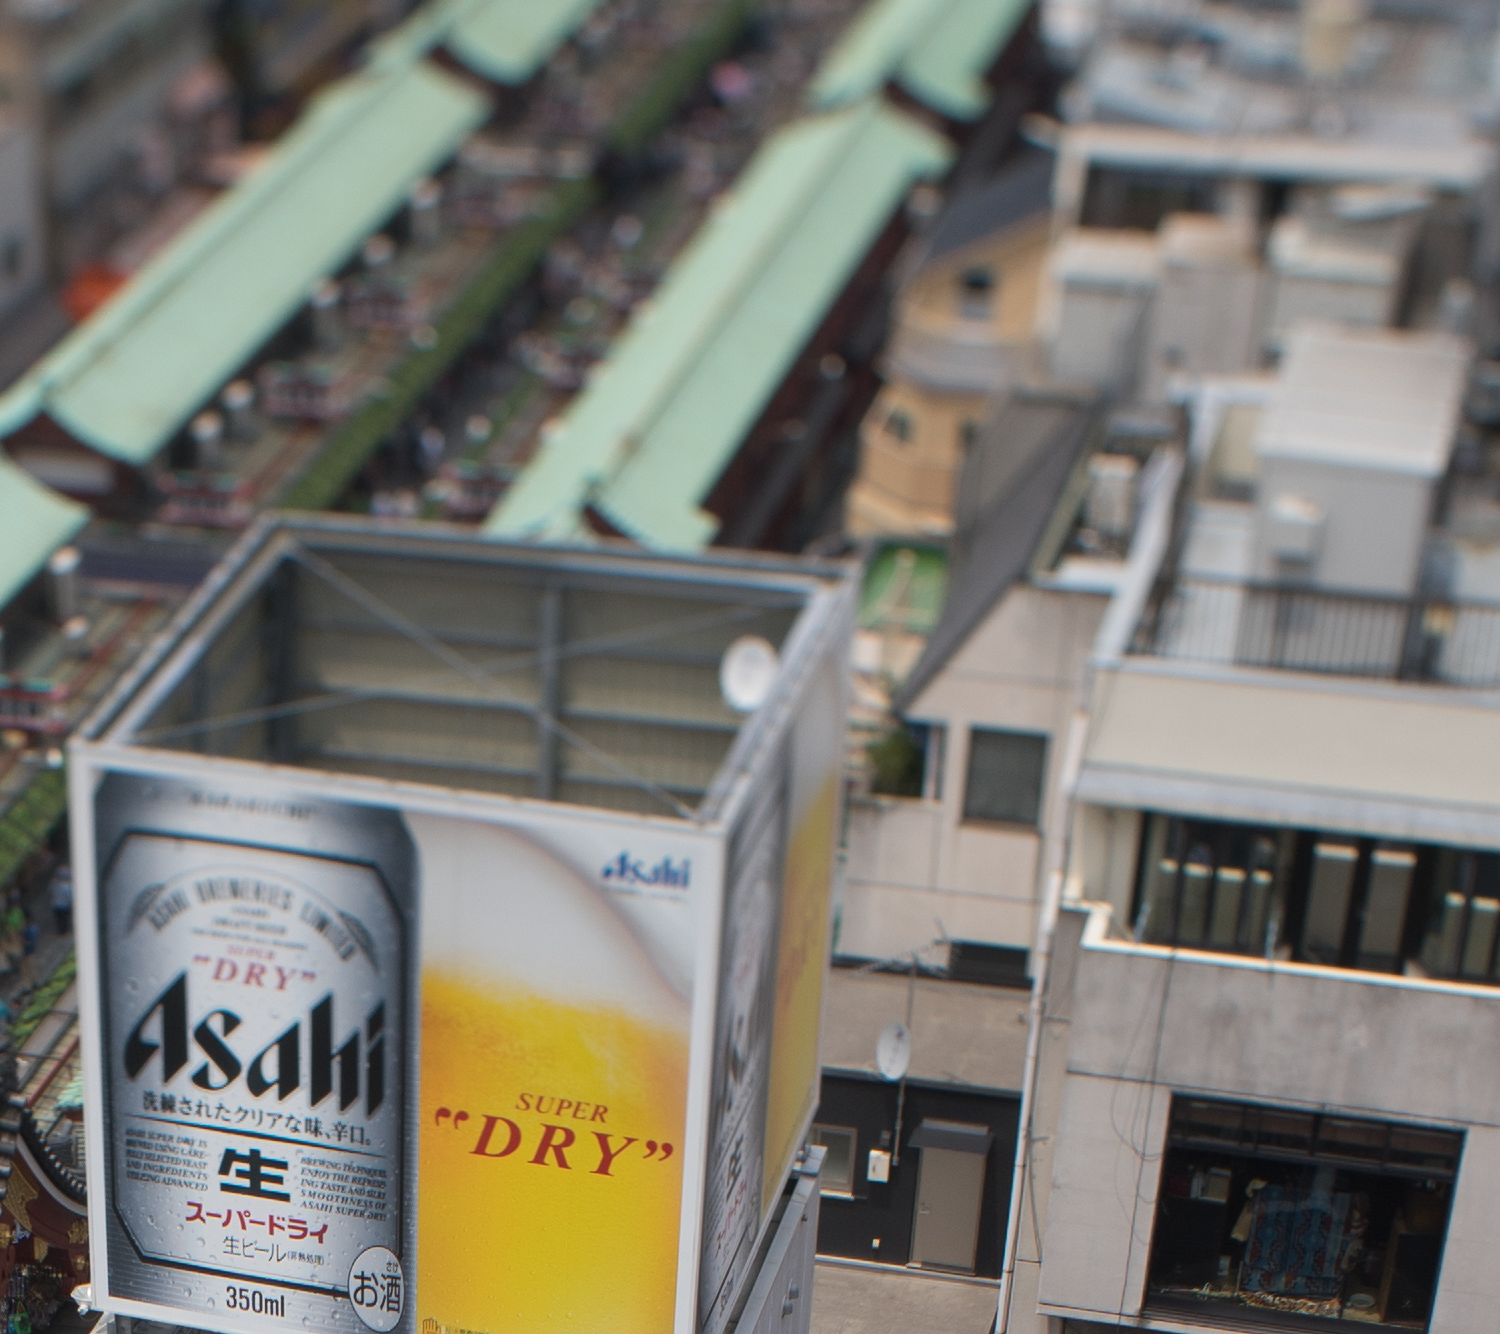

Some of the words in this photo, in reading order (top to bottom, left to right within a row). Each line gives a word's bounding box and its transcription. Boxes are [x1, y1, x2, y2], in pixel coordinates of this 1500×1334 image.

[602, 851, 691, 888] Asahi
[124, 969, 385, 1118] Asahi
[142, 1089, 372, 1146] 洗練されたクリアな味、辛口。
[515, 1092, 609, 1124] SUPER
[217, 1147, 290, 1203] 生
[185, 1200, 329, 1245] スーパードライ
[225, 1285, 286, 1318] 350ml
[353, 1270, 402, 1314] お酒
